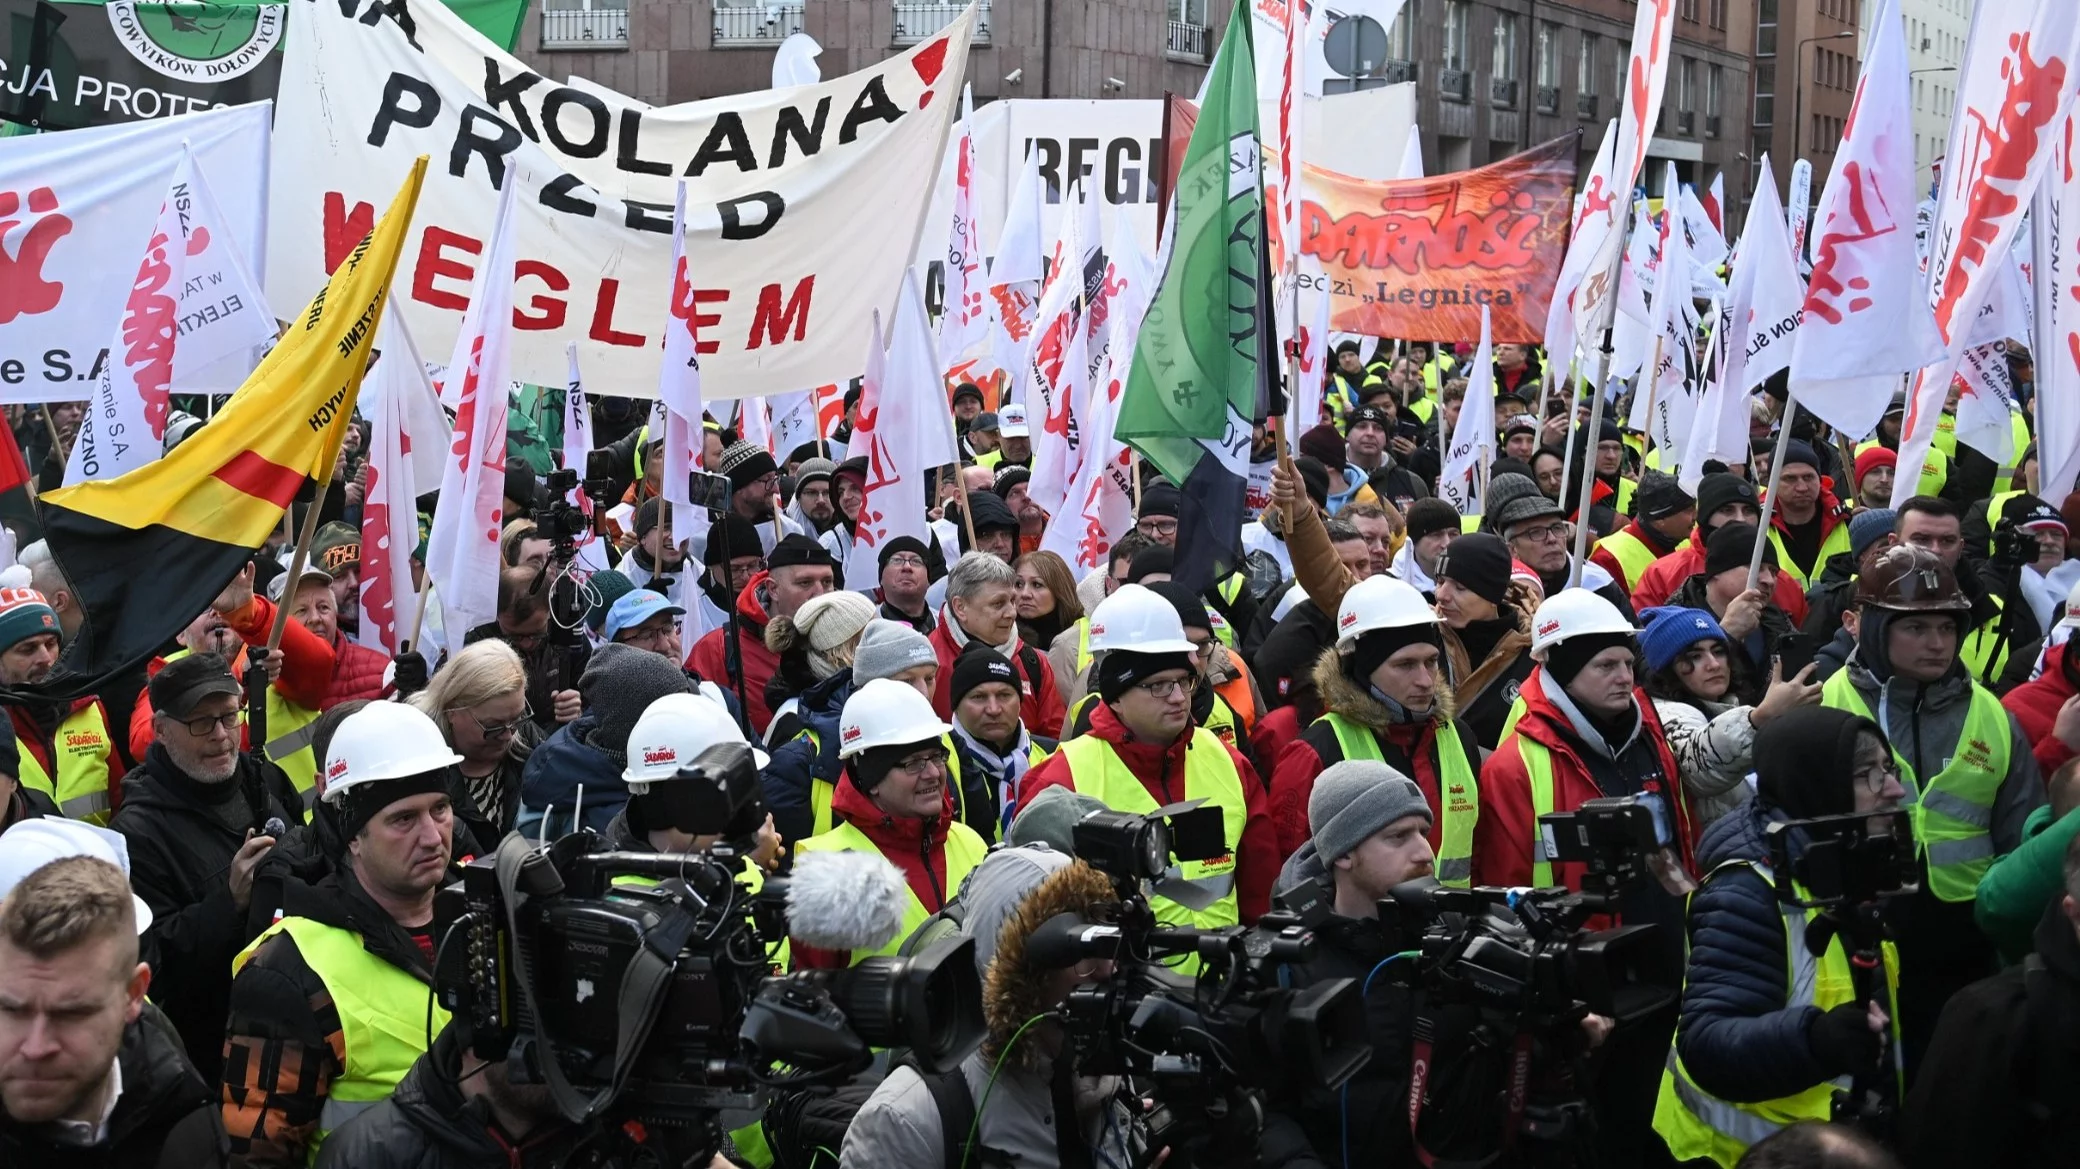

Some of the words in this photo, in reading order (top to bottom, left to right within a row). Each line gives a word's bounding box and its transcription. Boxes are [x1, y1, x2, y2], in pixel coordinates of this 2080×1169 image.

[114, 2, 198, 76] COWNIKÓW
[484, 37, 949, 177] KOLANA!
[367, 72, 785, 240] PRZED
[1025, 137, 1160, 205] REGI
[1298, 269, 1356, 298] edzi
[1963, 350, 1983, 371] owie
[82, 400, 99, 476] ORZNO
[1473, 980, 1505, 995] SONY
[1510, 1050, 1529, 1113] Canon
